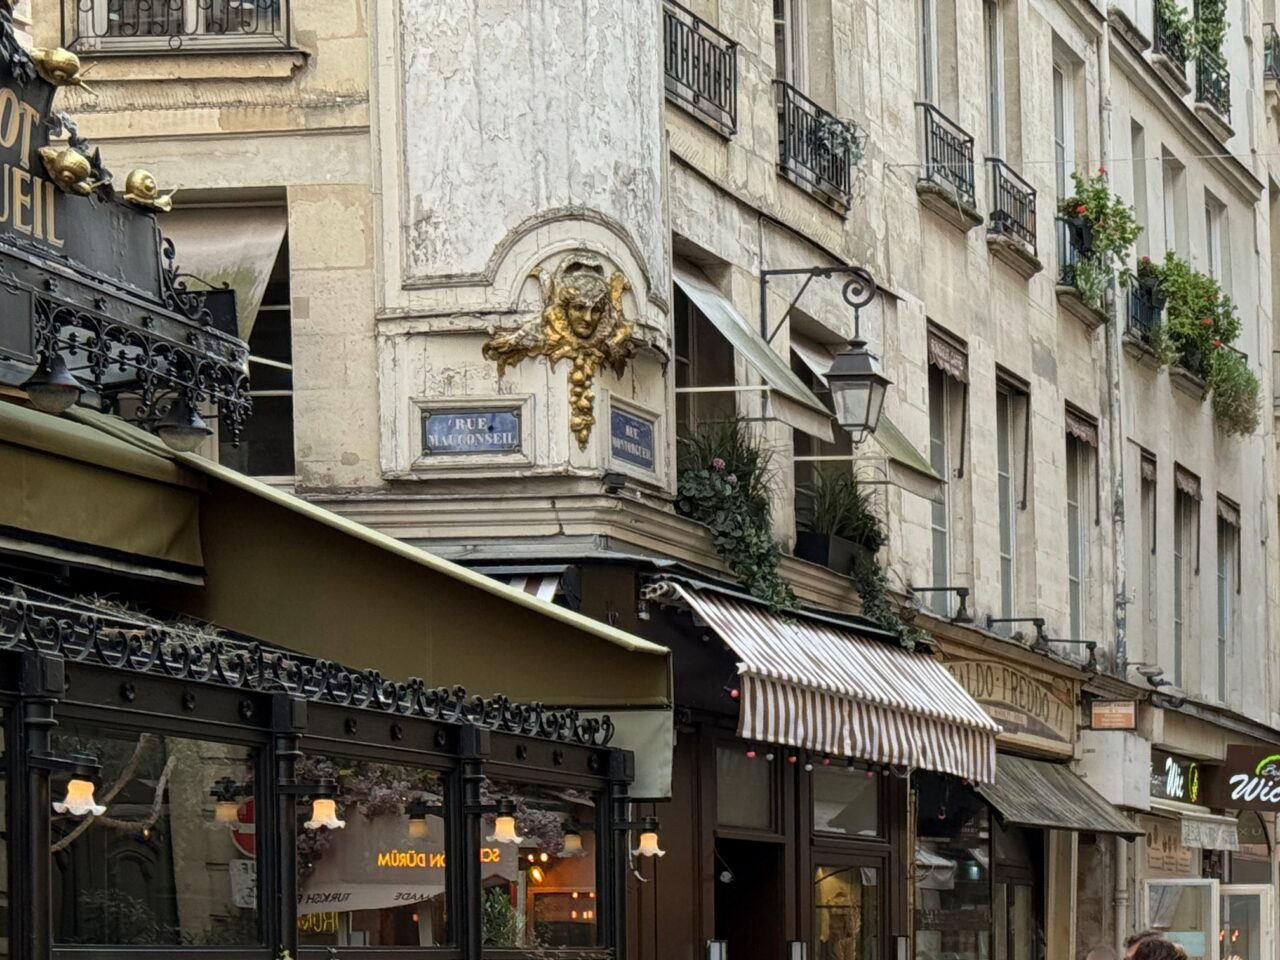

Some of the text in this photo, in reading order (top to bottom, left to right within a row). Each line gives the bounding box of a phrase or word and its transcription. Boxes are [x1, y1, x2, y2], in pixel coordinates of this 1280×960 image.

[455, 417, 487, 431] RUE
[428, 432, 517, 447] MAUCONSEIL
[1002, 667, 1050, 723] FREDDO
[1165, 757, 1184, 798] Wic
